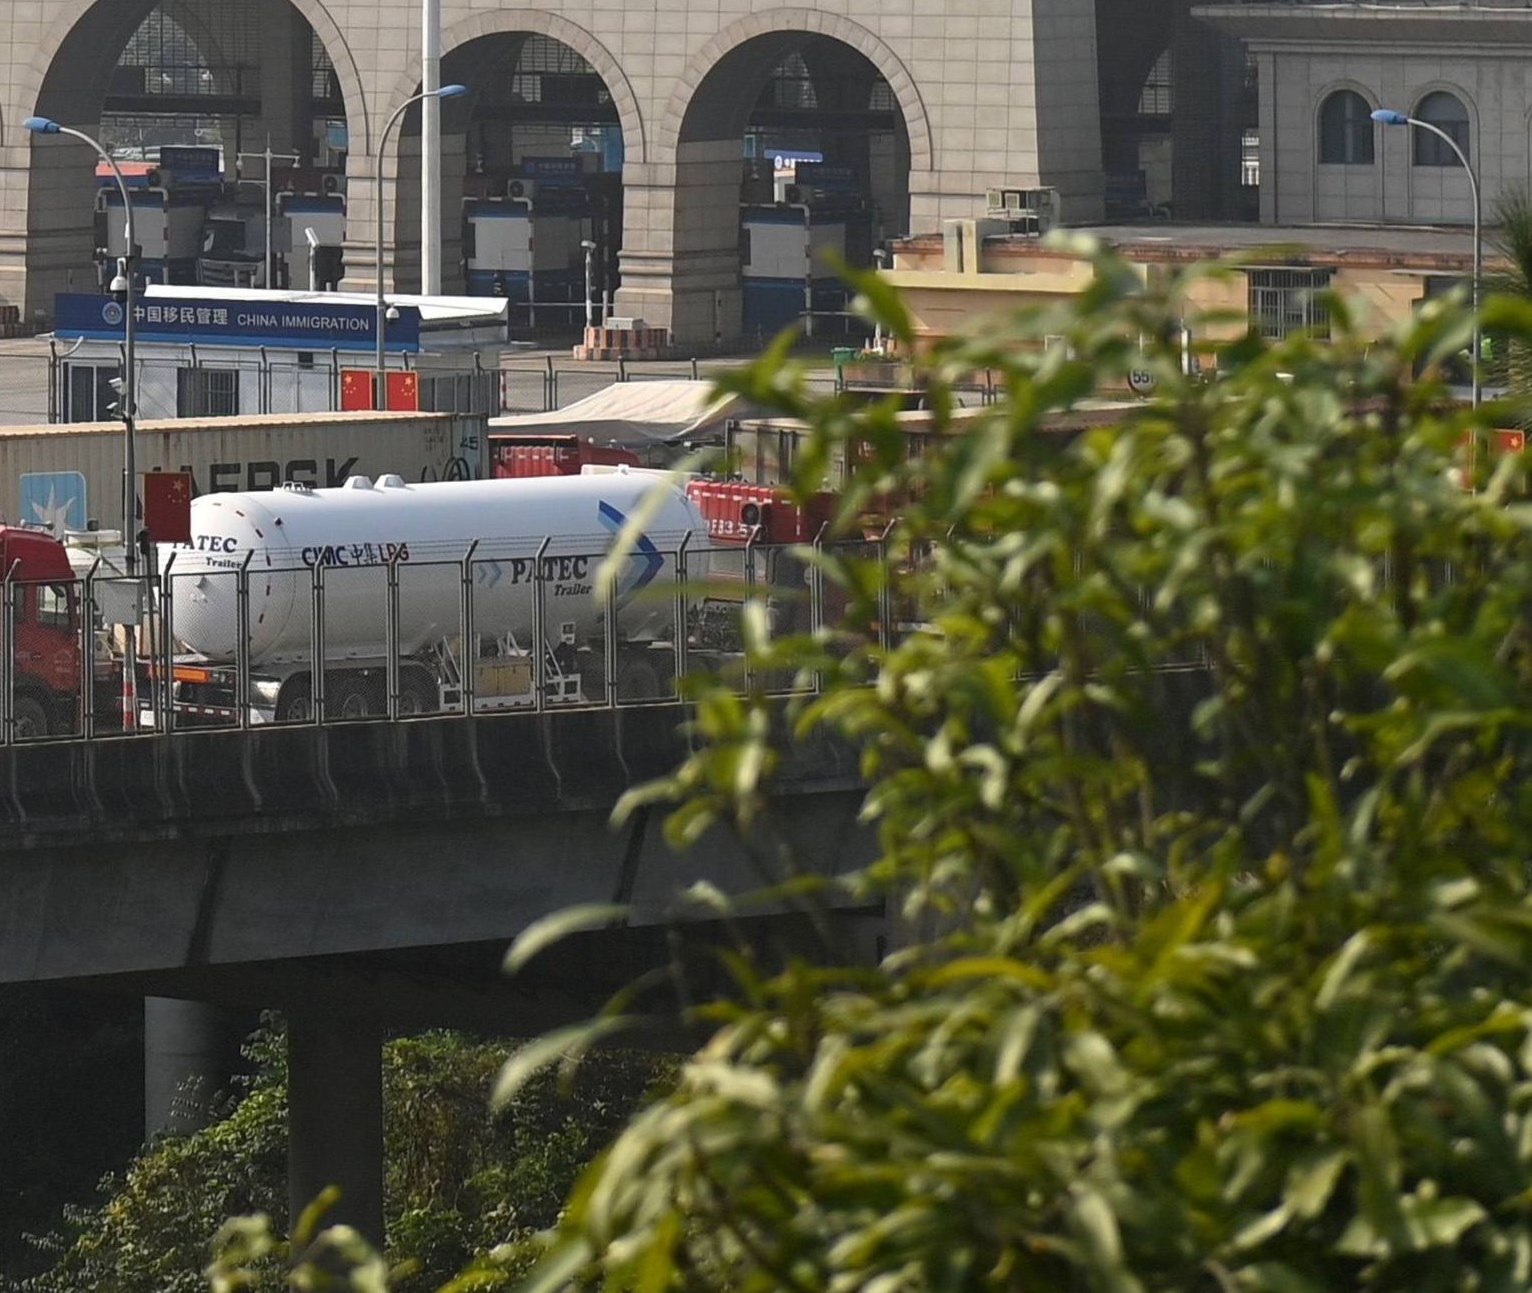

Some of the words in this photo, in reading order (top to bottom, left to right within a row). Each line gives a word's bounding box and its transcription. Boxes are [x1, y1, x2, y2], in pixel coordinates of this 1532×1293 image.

[133, 305, 228, 326] 中国移民管理
[236, 313, 279, 327] CHINA
[281, 315, 370, 331] IMMIGRATION
[460, 436, 479, 450] 45
[172, 535, 237, 553] TEC
[205, 556, 242, 570] Trailer
[301, 545, 348, 567] CIMC
[378, 542, 410, 563] LPG
[553, 583, 592, 596] Trailer
